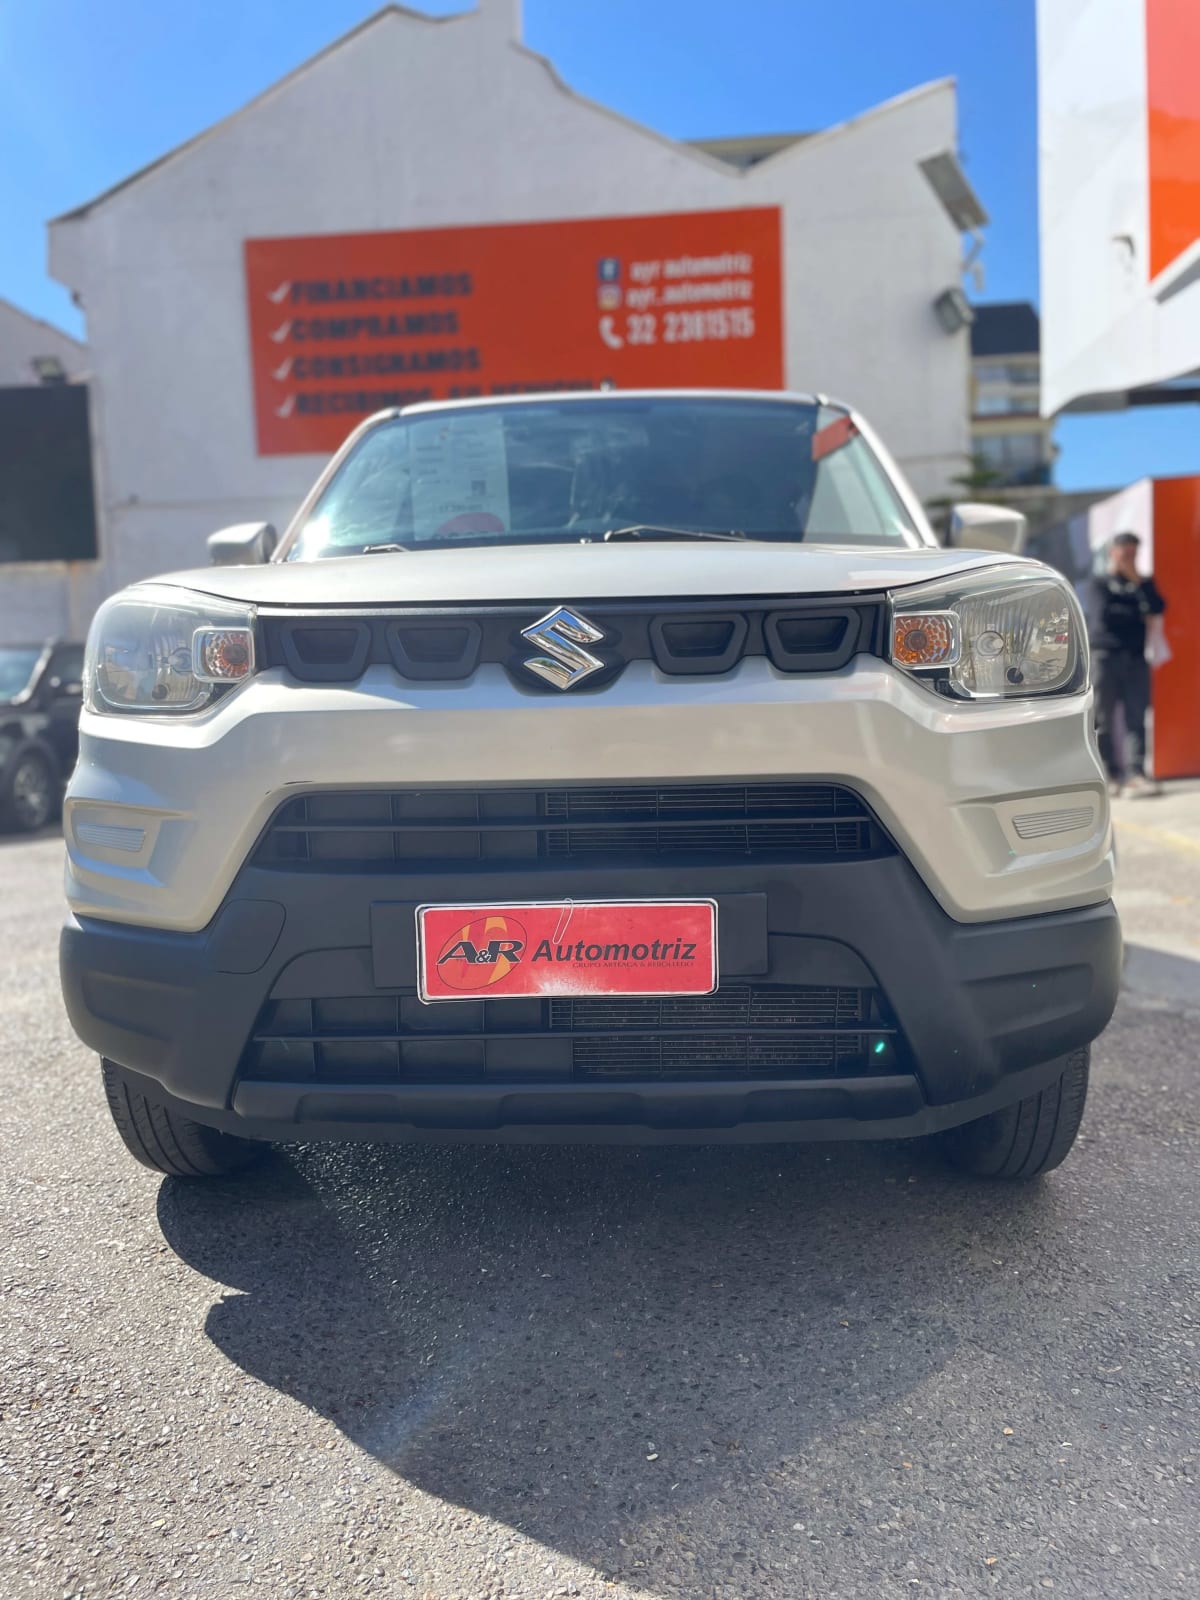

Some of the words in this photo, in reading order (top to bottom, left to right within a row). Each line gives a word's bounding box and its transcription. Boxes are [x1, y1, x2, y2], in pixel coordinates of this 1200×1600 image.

[292, 272, 471, 303] FINANCIAMOS
[292, 311, 458, 342] COMPRAMOS
[626, 313, 656, 345] 32
[293, 347, 480, 380] CONSIGNAMOS
[436, 940, 525, 965] A&R
[531, 938, 697, 962] Automotriz
[572, 961, 600, 969] GRUPO
[603, 961, 638, 969] ARTEAGA
